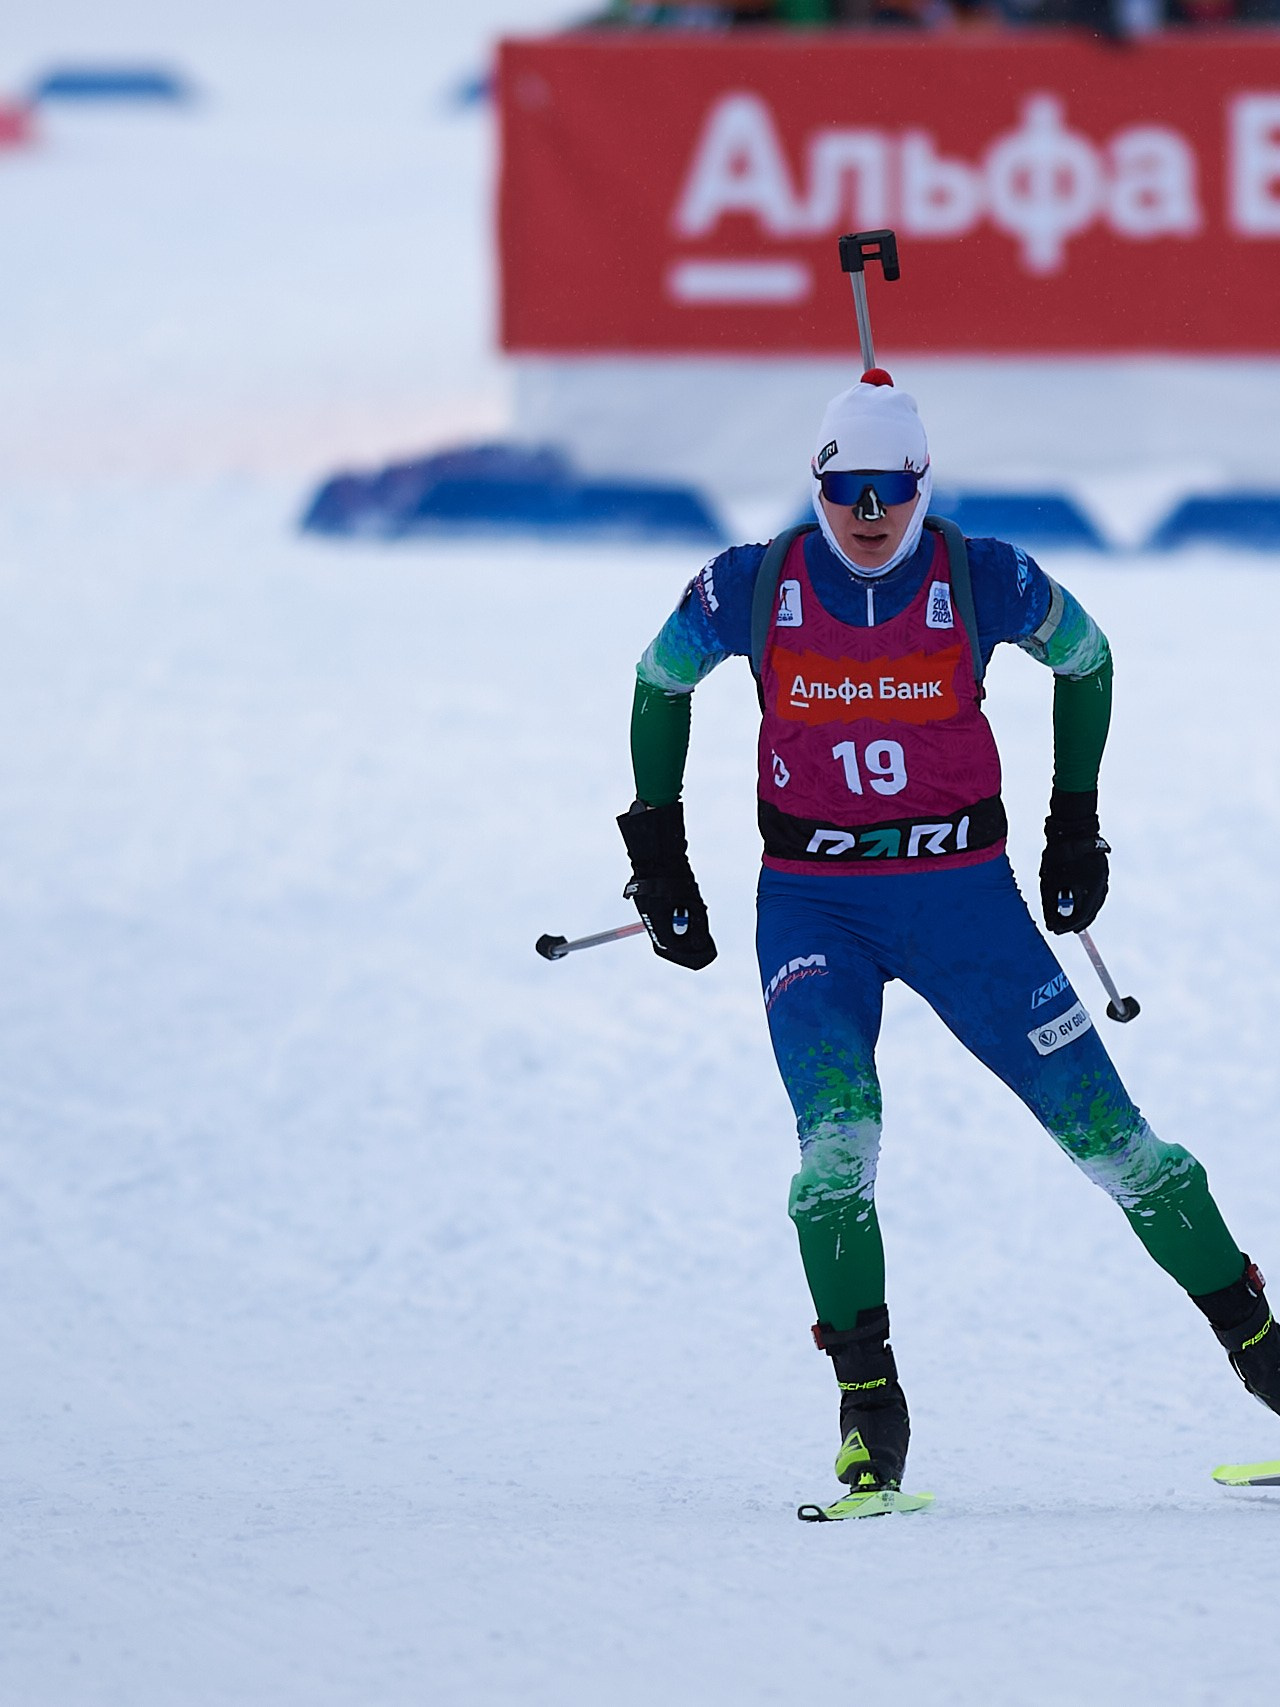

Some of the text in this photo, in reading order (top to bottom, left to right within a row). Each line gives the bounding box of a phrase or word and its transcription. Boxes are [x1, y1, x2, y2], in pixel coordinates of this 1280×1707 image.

[676, 93, 1197, 272] Альфа
[790, 674, 943, 705] Альфа Банк
[832, 739, 908, 795] 19
[1059, 1020, 1073, 1036] GV
